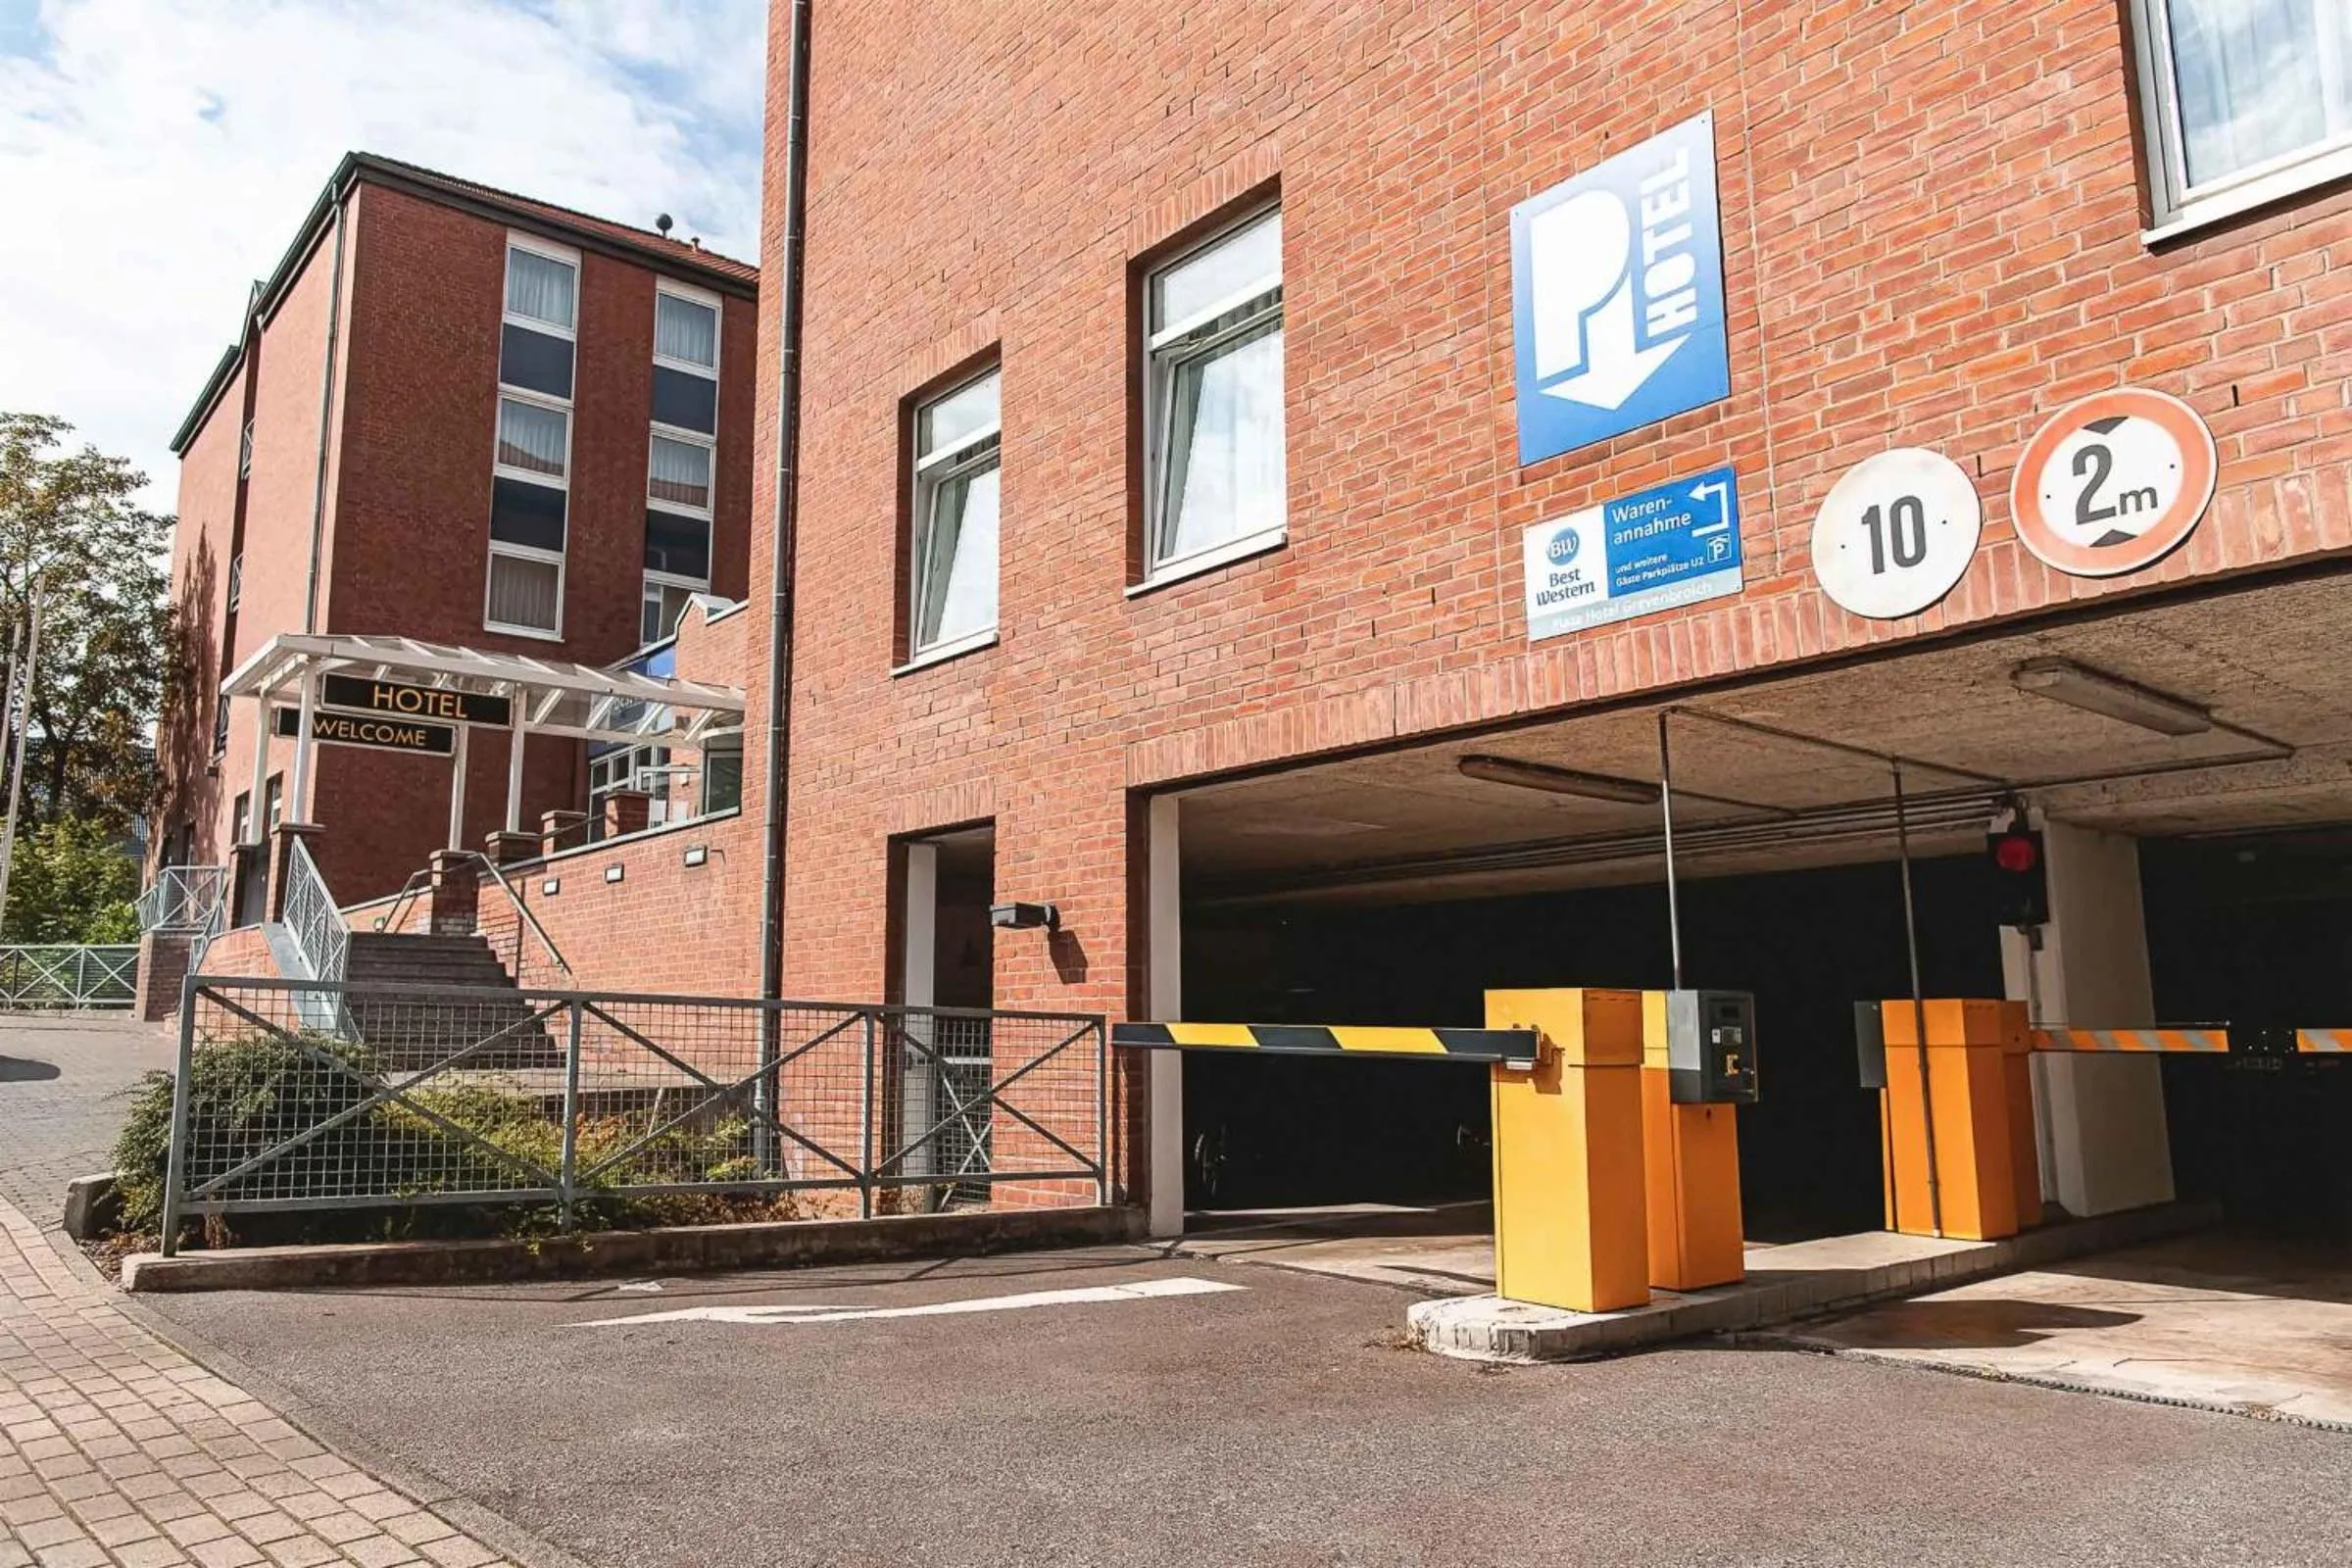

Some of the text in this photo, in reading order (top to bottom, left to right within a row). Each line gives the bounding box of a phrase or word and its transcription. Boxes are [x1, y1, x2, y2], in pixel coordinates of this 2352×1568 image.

[1640, 147, 1696, 337] HOTEL
[1611, 497, 1672, 523] Waren-
[1613, 513, 1691, 545] annahme
[1861, 495, 1926, 574] 10
[1549, 537, 1577, 558] BW
[1549, 568, 1581, 587] Best
[1536, 581, 1595, 606] Western
[373, 686, 467, 718] HOTEL
[313, 719, 426, 746] WELCOME
